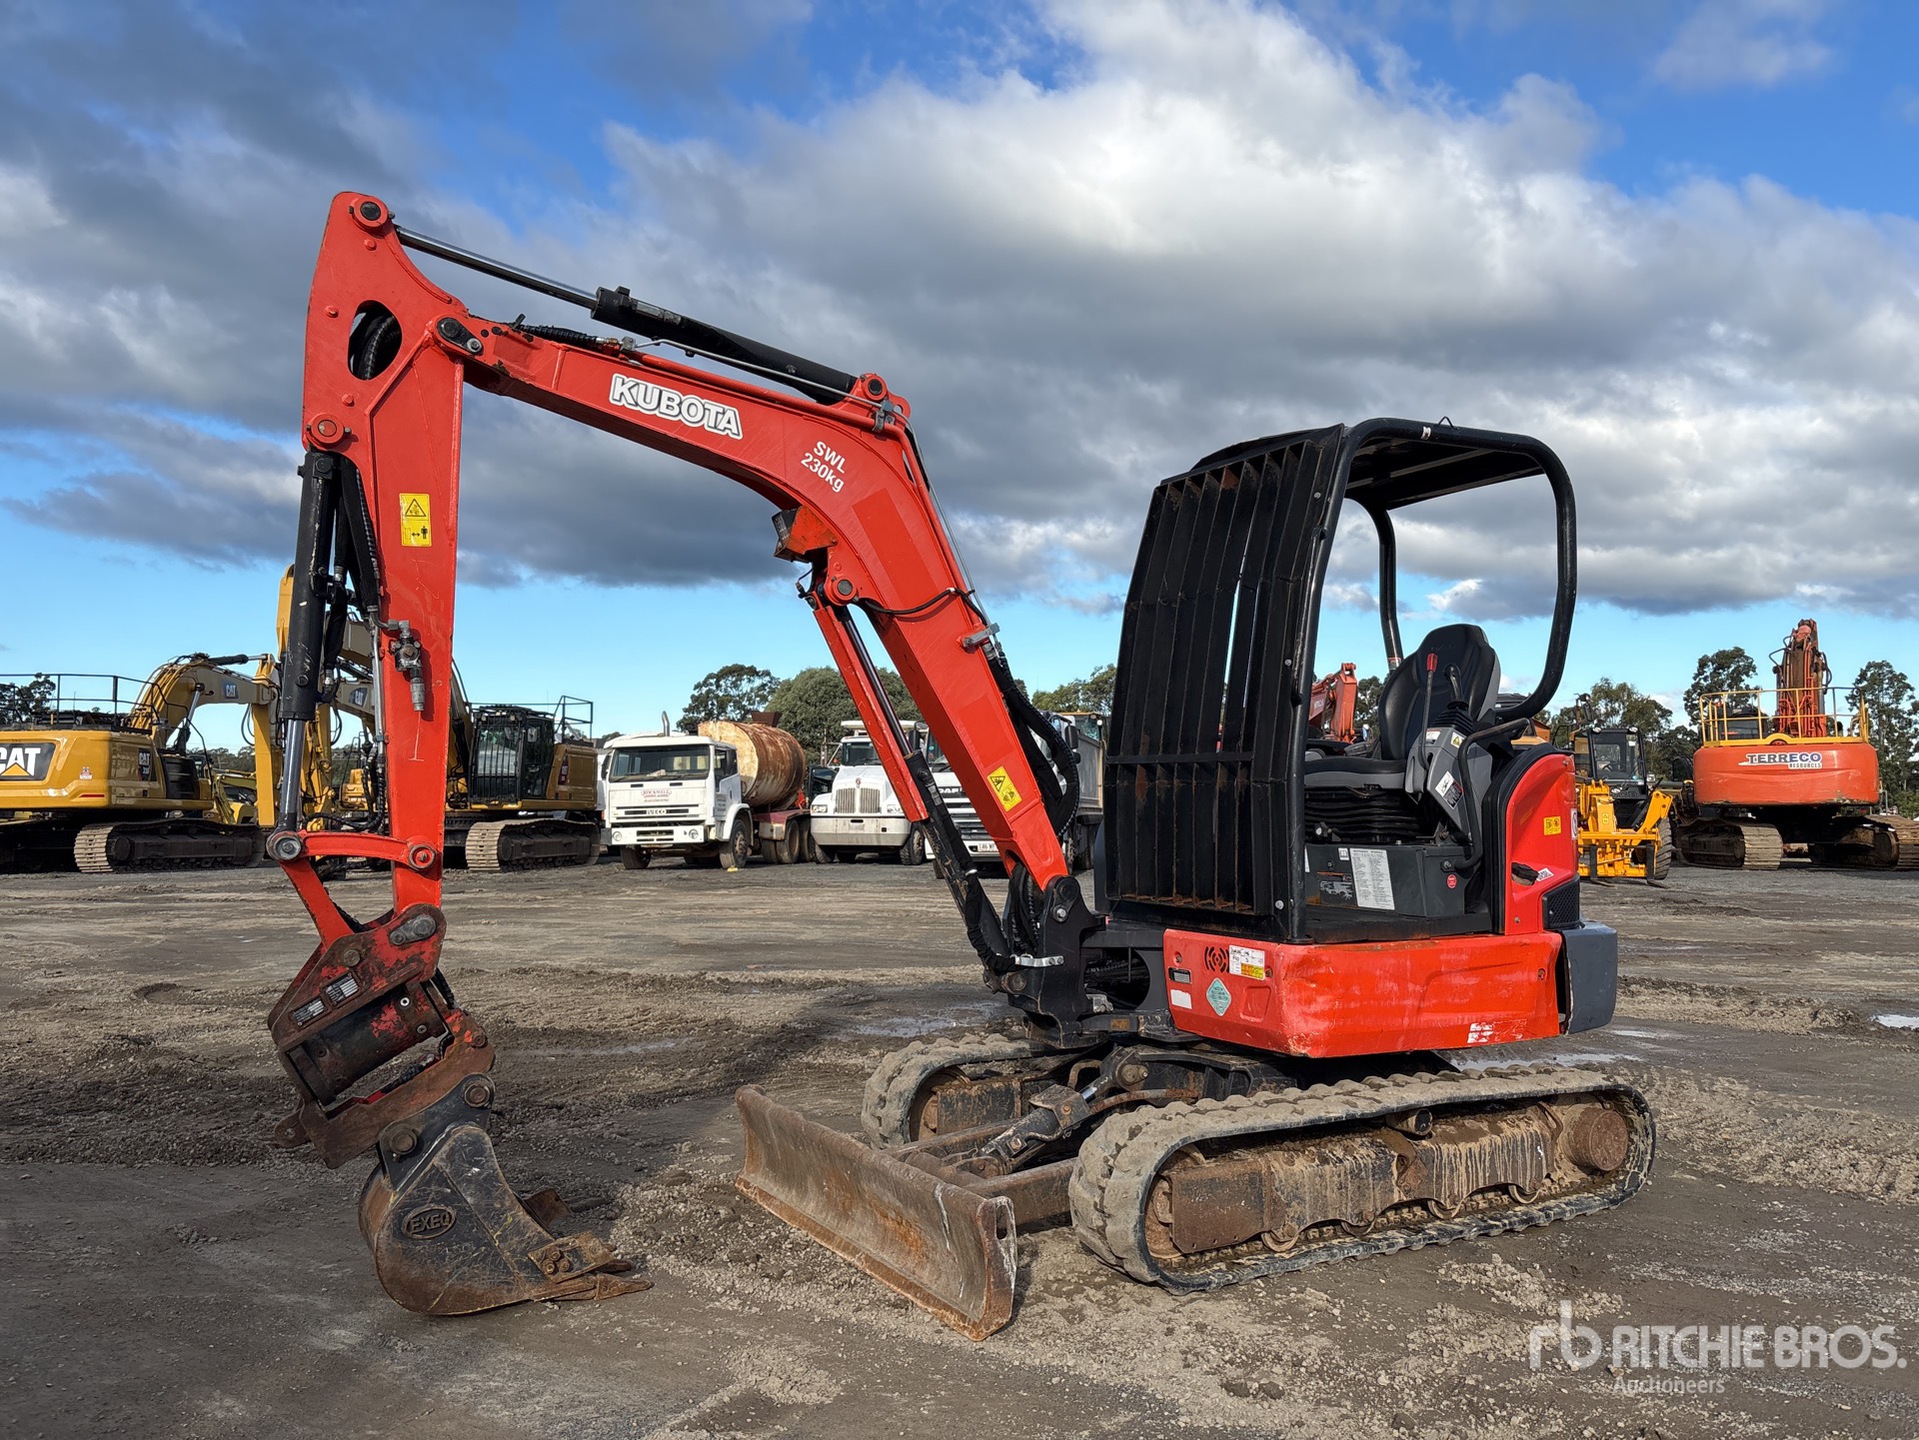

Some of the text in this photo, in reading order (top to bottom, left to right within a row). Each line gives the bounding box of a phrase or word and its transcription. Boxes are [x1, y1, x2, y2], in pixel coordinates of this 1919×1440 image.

[609, 374, 742, 439] KUBOTA
[813, 440, 846, 473] SWL
[801, 452, 845, 493] 230kg
[225, 684, 237, 697] CAT
[139, 752, 150, 765] CAT
[1747, 752, 1822, 764] TERRECO
